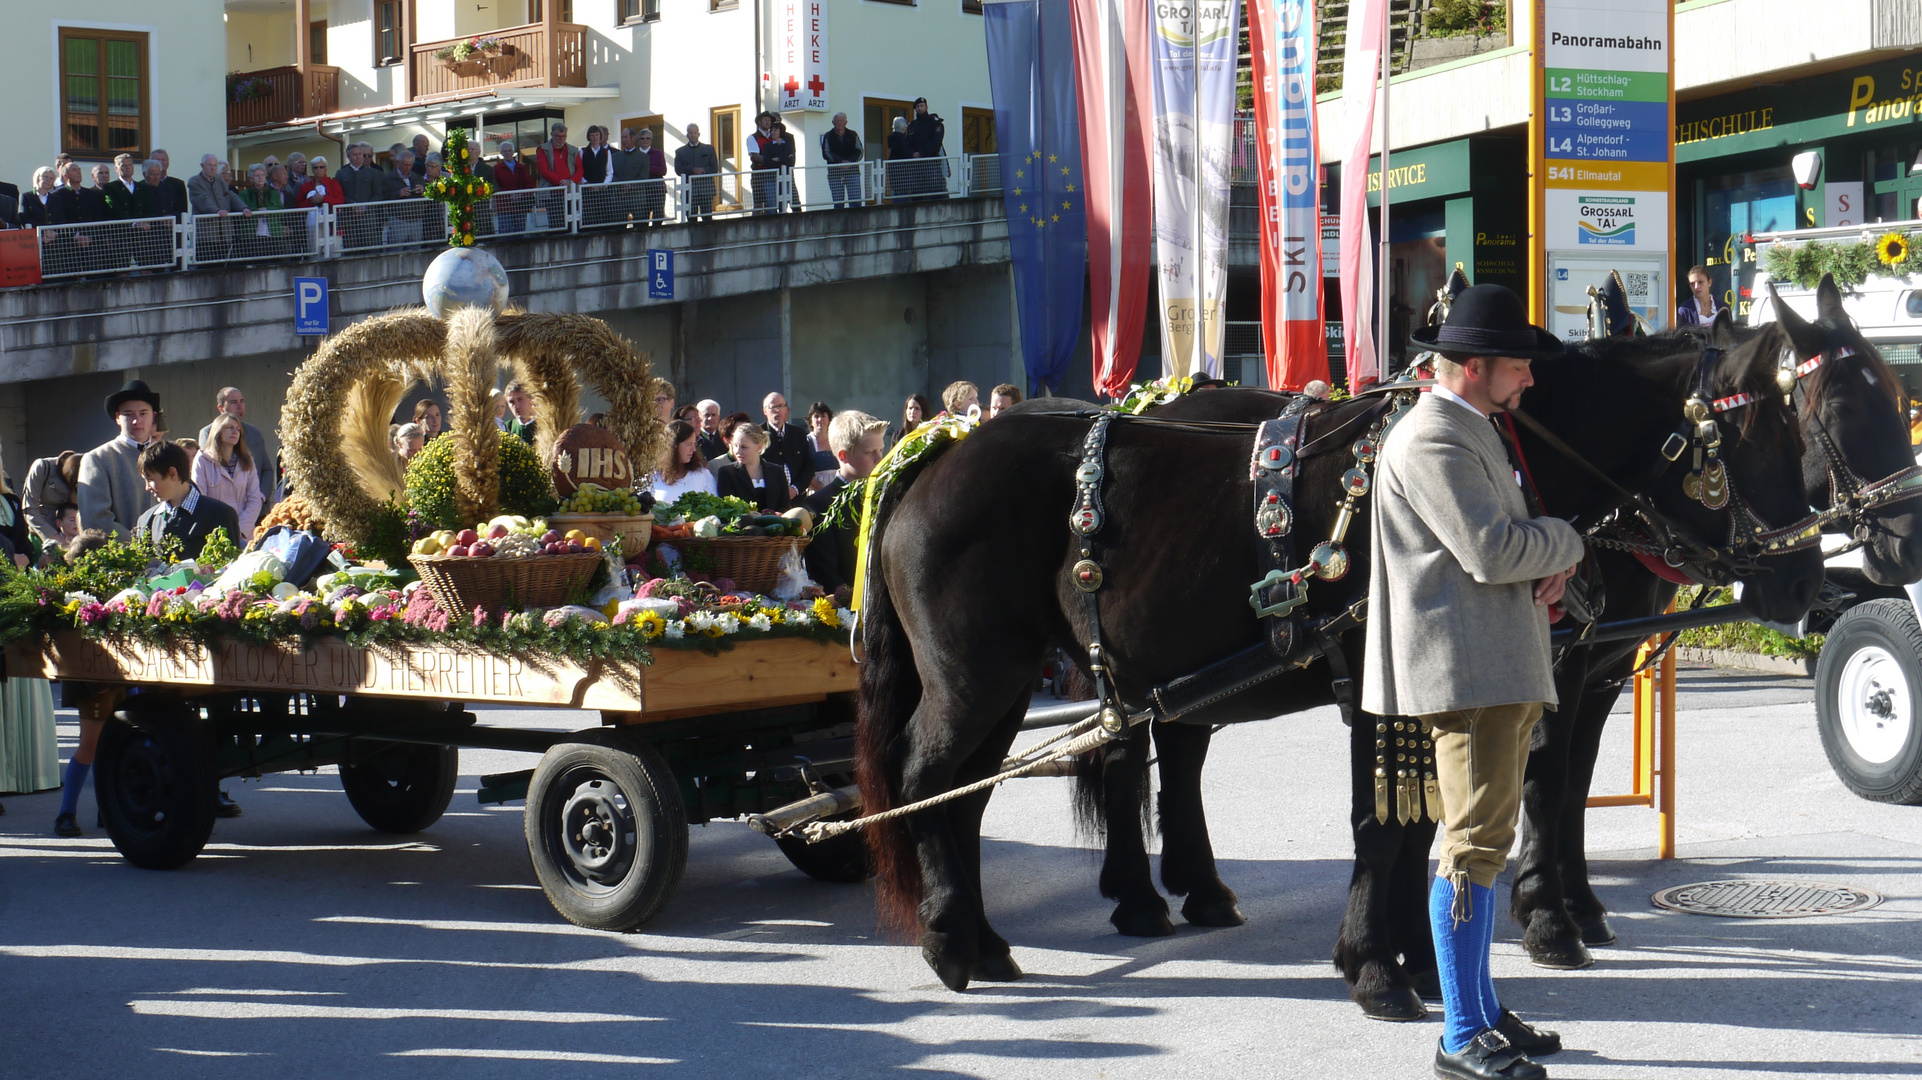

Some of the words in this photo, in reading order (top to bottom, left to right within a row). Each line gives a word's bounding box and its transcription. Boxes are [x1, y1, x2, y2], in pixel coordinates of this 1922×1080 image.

[811, 3, 820, 63] HEKE
[1551, 32, 1662, 50] Panoramabahn
[1550, 77, 1572, 92] L2
[1577, 73, 1631, 87] Hüttschlag-
[1577, 86, 1624, 97] Stockham
[784, 99, 800, 108] ARZT
[808, 99, 825, 108] ARZT
[1577, 103, 1616, 115] Großarl-
[1550, 106, 1572, 122] L3
[1577, 116, 1631, 129] Golleggweg
[1550, 137, 1572, 153] L4
[1577, 134, 1624, 145] Alpendorf
[1577, 146, 1590, 156] St.
[1592, 147, 1627, 158] Johann
[1548, 167, 1575, 180] 541
[1577, 170, 1622, 181] Ellmautal
[1267, 127, 1279, 248] DABEI
[1580, 206, 1634, 218] GROSSARL
[1597, 218, 1617, 229] TAL
[1476, 232, 1516, 246] Panorama
[1724, 235, 1735, 264] 6
[658, 254, 664, 268] P
[1283, 236, 1306, 294] SKI
[1558, 271, 1568, 279] L4
[300, 282, 322, 319] P
[1168, 305, 1215, 321] Groer
[577, 448, 627, 480] IHS
[331, 648, 377, 689] UND
[391, 650, 523, 697] HERREITER
